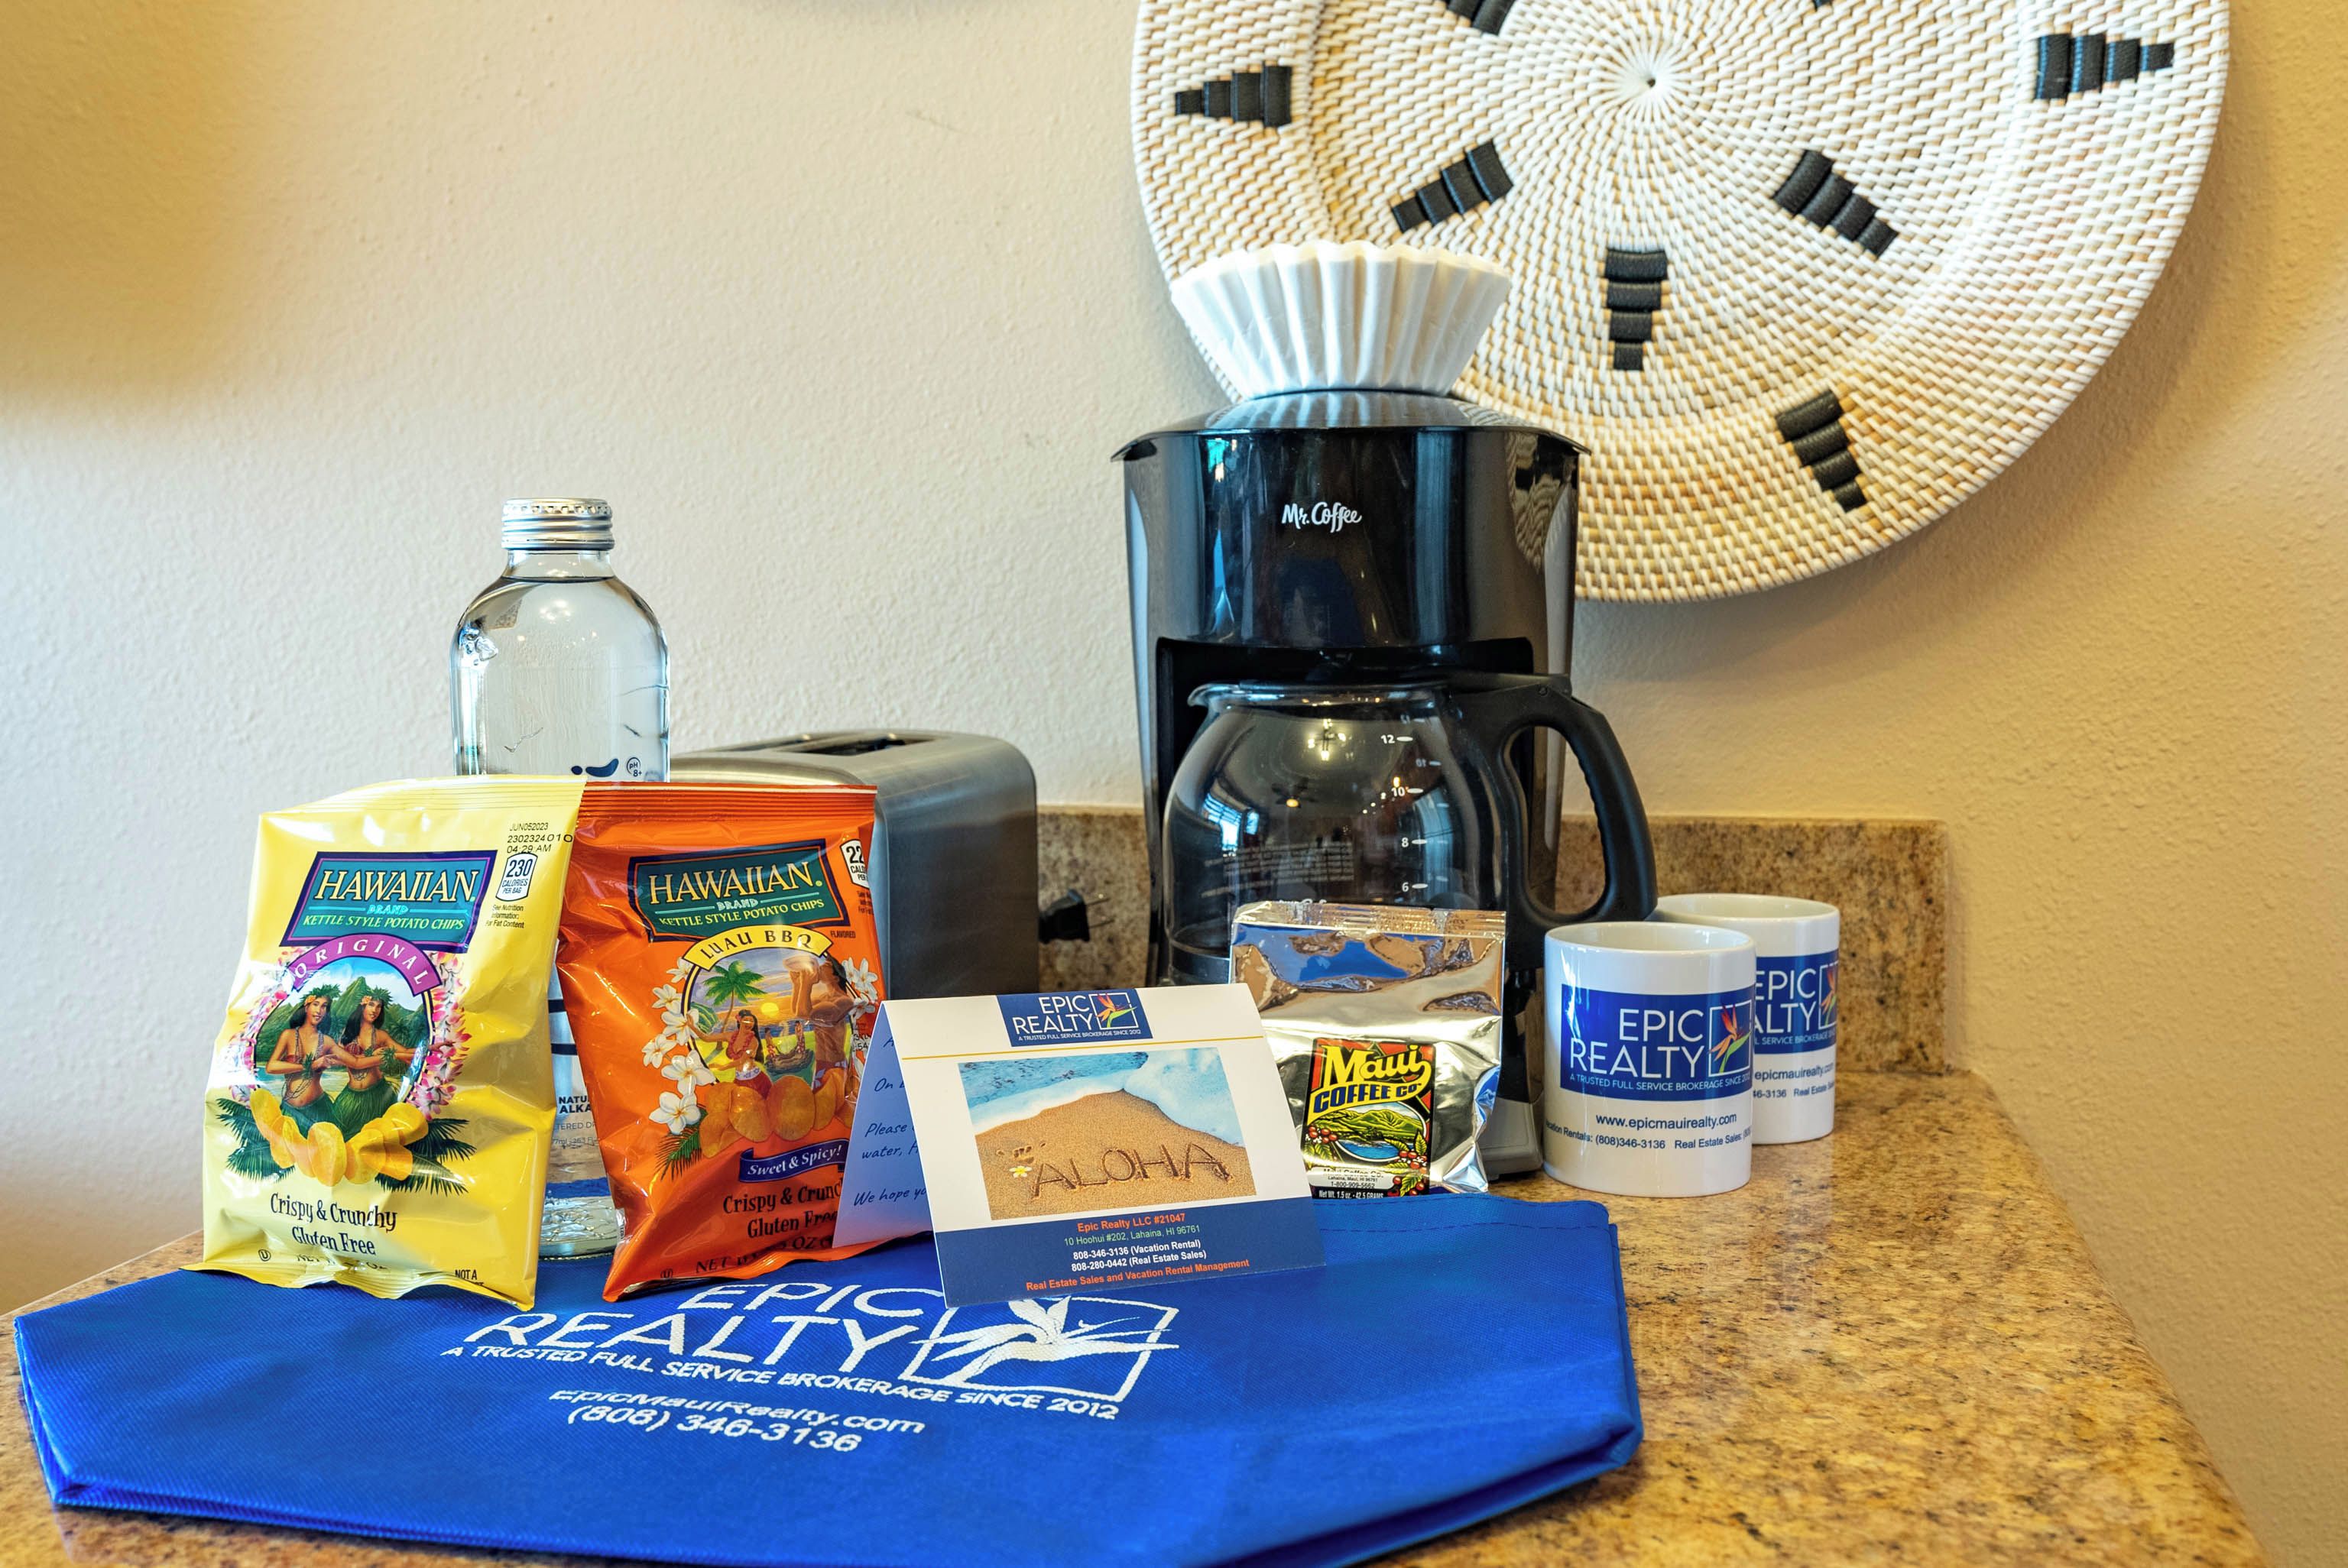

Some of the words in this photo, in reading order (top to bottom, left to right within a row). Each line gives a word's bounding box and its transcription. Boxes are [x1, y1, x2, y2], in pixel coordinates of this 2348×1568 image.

[1282, 503, 1309, 530] Mr.
[1311, 501, 1362, 533] Coffee
[1380, 734, 1395, 744] 12
[1391, 786, 1406, 797] 10
[510, 822, 549, 831] JUN052023
[507, 845, 533, 854] 04:29
[535, 844, 552, 853] AM
[1401, 837, 1409, 847] 8
[846, 845, 864, 864] 22
[506, 858, 533, 878] 230
[313, 869, 479, 903] HAWAIIAN
[502, 878, 528, 888] CALORIES
[649, 861, 814, 905] HAWAIIAN
[1402, 882, 1409, 893] 6
[366, 904, 409, 916] BRAND
[659, 915, 704, 927] KETTLE
[704, 910, 742, 925] STYLE
[743, 904, 789, 920] POTATO
[790, 899, 825, 912] CHIPS
[716, 898, 759, 911] BRAND
[303, 915, 346, 927] KETTLE
[347, 915, 381, 928] STYLE
[384, 916, 429, 929] POTATO
[430, 918, 465, 931] CHIPS
[504, 920, 524, 928] Content
[699, 931, 754, 959] LUAU
[764, 929, 812, 949] BBQ
[294, 938, 429, 985] ORIGINAL
[1755, 968, 1817, 1001] EPIC
[1038, 995, 1091, 1015] EPIC
[1012, 1013, 1094, 1035] REALTY
[1619, 1008, 1704, 1043] EPIC
[1754, 1001, 1817, 1034] ALTY
[1082, 1030, 1114, 1038] BROKERAGE
[1762, 1036, 1793, 1045] SERVICE
[1321, 1045, 1421, 1089] Maui
[1570, 1038, 1705, 1079] REALTY
[874, 1077, 893, 1093] On
[1577, 1074, 1610, 1087] TRUSTED
[1612, 1080, 1633, 1090] FULL
[1636, 1081, 1673, 1092] SERVICE
[1675, 1079, 1724, 1091] BROKERAGE
[1724, 1075, 1742, 1087] SINCE
[1793, 1087, 1810, 1097] Real
[559, 1095, 591, 1104] NATU
[1313, 1083, 1391, 1113] COFFEE
[559, 1103, 592, 1114] ALKA
[556, 1122, 584, 1131] TERED
[864, 1122, 908, 1138] Please
[1595, 1113, 1737, 1131] www.epicmauirealty.com
[1563, 1126, 1594, 1143] Rentals:
[1595, 1134, 1666, 1149] (808)346-3136
[1674, 1139, 1696, 1149] Real
[1698, 1136, 1724, 1148] Estate
[748, 1160, 786, 1176] Sweet
[788, 1156, 799, 1170] &
[801, 1145, 842, 1166] Spicy!
[861, 1146, 903, 1160] water,
[1032, 1142, 1233, 1198] ALOHA
[723, 1194, 777, 1214] Crispy
[780, 1186, 793, 1205] &
[797, 1178, 844, 1204] Crunc
[854, 1191, 875, 1207] We
[879, 1187, 910, 1203] hope
[914, 1187, 927, 1200] yo
[1318, 1190, 1327, 1198] Net
[1337, 1191, 1345, 1199] 1.5
[271, 1191, 313, 1223] Crispy
[316, 1199, 328, 1221] &
[330, 1201, 398, 1233] Crunchy
[747, 1216, 799, 1238] Gluten
[1076, 1222, 1099, 1233] Epic
[1101, 1219, 1130, 1231] Realty
[1132, 1216, 1151, 1227] LLC
[1153, 1213, 1185, 1224] #21047
[292, 1225, 340, 1252] Gluten
[338, 1232, 377, 1256] Free
[1064, 1237, 1075, 1246] 10
[1076, 1234, 1105, 1246] Hoohui
[1106, 1232, 1130, 1242] #202,
[1130, 1229, 1165, 1240] Lahaina,
[1166, 1227, 1175, 1236] HI
[1176, 1224, 1201, 1234] 96761
[1072, 1246, 1129, 1261] 808-346-3136
[1130, 1242, 1170, 1256] (Vacation
[1170, 1239, 1202, 1250] Rental)
[696, 1256, 731, 1274] NET
[1071, 1258, 1128, 1272] 808-280-0442
[1129, 1255, 1151, 1268] (Real
[1152, 1252, 1179, 1264] Estate
[1180, 1249, 1207, 1261] Sales)
[455, 1269, 471, 1279] NOT
[471, 1269, 478, 1280] A
[1025, 1281, 1047, 1291] Real
[1049, 1278, 1078, 1289] Estate
[1079, 1275, 1104, 1286] Sales
[1106, 1272, 1124, 1282] and
[1124, 1268, 1164, 1280] Vacation
[1164, 1265, 1193, 1276] Rental
[1194, 1258, 1250, 1273] Management
[676, 1282, 944, 1318] EPIC
[462, 1312, 919, 1373] REALTY
[439, 1346, 463, 1357] A
[472, 1345, 587, 1363] TRUSTED
[589, 1351, 655, 1373] FULL
[660, 1360, 777, 1385] SERVICE
[777, 1371, 951, 1403] BROKERAGE
[955, 1390, 1042, 1411] SINCE
[1046, 1397, 1120, 1421] 2012
[548, 1389, 926, 1434] EpicMauiRealty.com
[567, 1404, 671, 1434] (808)
[676, 1414, 864, 1453] 346-3136
